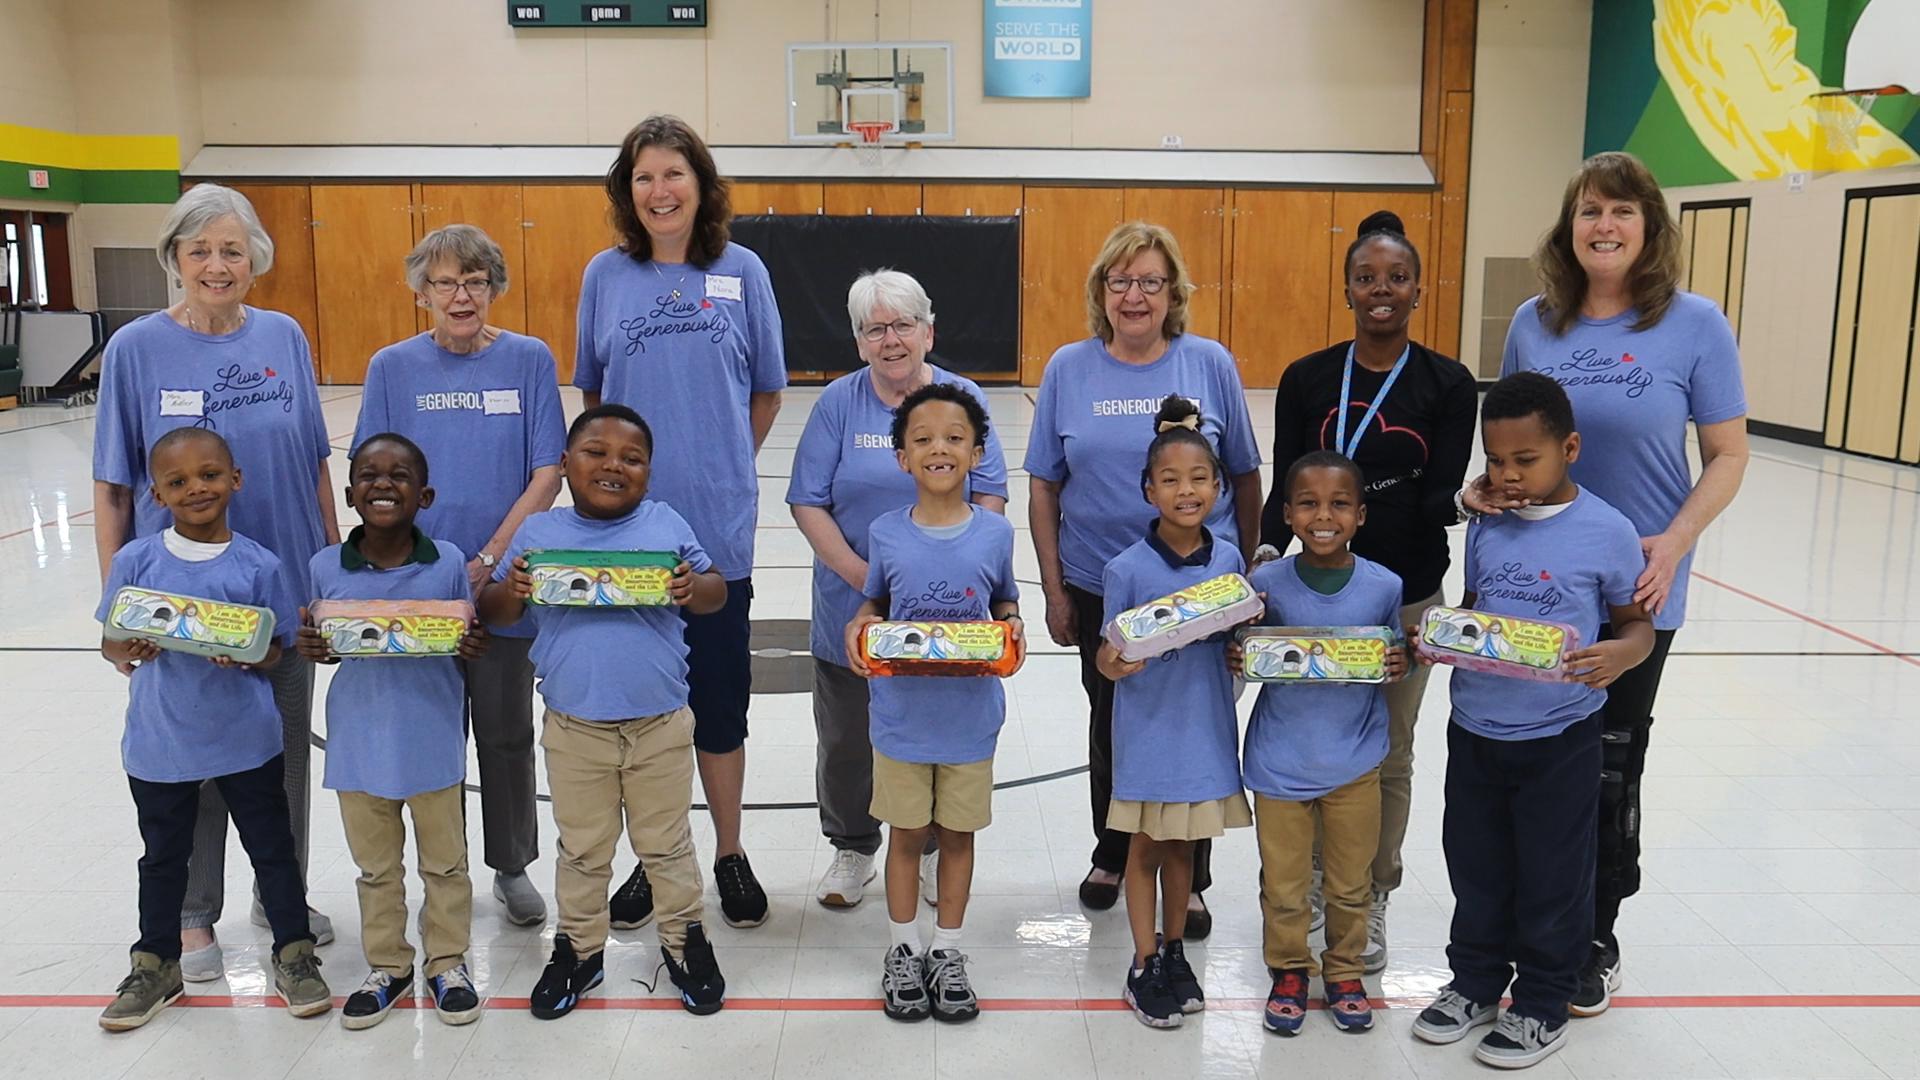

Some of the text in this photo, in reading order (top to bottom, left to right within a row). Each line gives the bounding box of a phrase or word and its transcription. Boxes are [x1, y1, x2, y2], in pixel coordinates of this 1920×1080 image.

[517, 7, 541, 19] won
[591, 7, 621, 21] game
[672, 7, 696, 19] won
[996, 22, 1080, 37] SERVE THE
[1000, 41, 1075, 55] WORLD
[649, 295, 704, 319] Live
[620, 314, 730, 357] Generously
[1559, 348, 1621, 373] Live
[213, 363, 268, 393] Live
[426, 391, 483, 410] GENEROU
[1102, 397, 1161, 416] GENEROU
[1495, 561, 1539, 588] Live
[921, 580, 966, 605] Live
